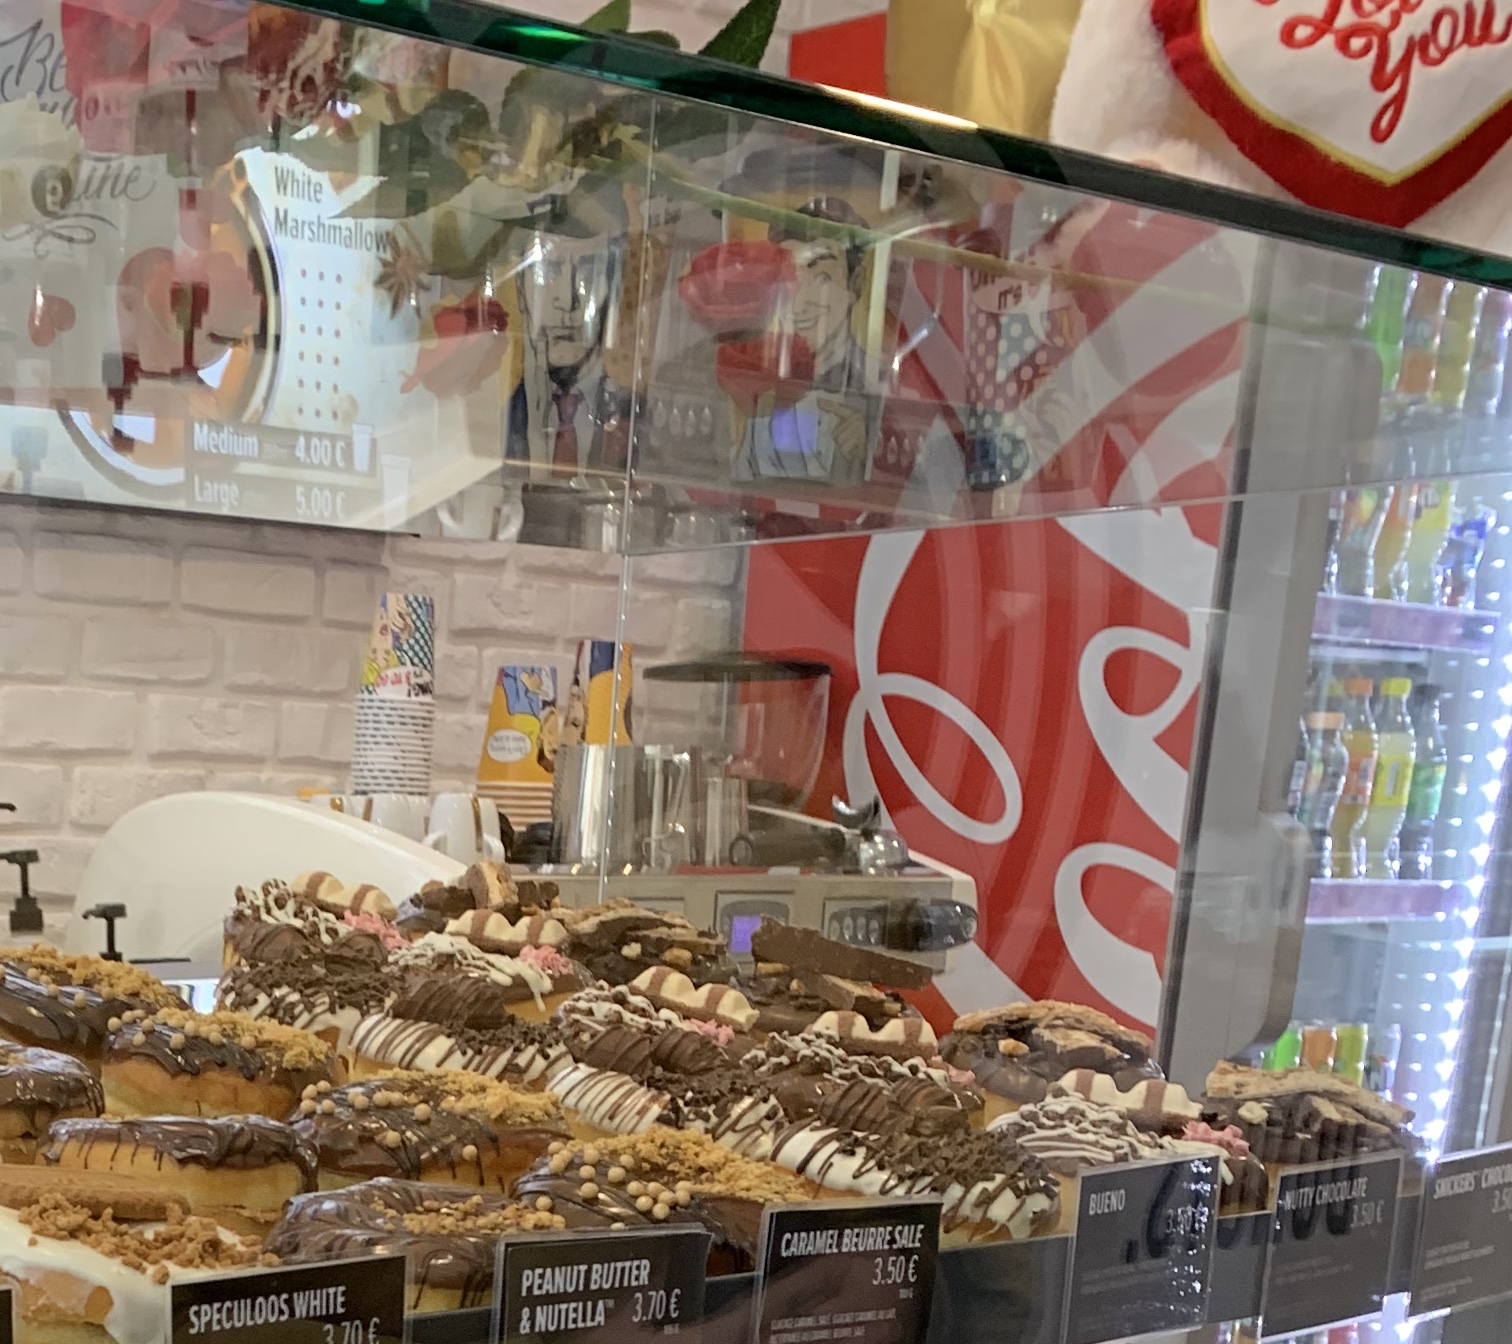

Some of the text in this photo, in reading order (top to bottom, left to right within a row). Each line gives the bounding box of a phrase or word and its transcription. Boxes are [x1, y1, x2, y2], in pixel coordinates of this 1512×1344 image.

[274, 166, 323, 204] White
[194, 422, 259, 458] Medium
[295, 435, 332, 467] 4.00
[194, 475, 240, 513] Large
[296, 485, 332, 517] 5.00
[1088, 1188, 1126, 1215] BUENO
[780, 1223, 925, 1257] CARAMEL BEURRE SALE
[520, 1258, 651, 1296] PEANUT BUTTER
[871, 1254, 920, 1286] 3.50 €
[188, 1284, 346, 1335] SPECULOOS WHITE
[519, 1305, 531, 1334] &
[632, 1287, 681, 1322] 3.70 €
